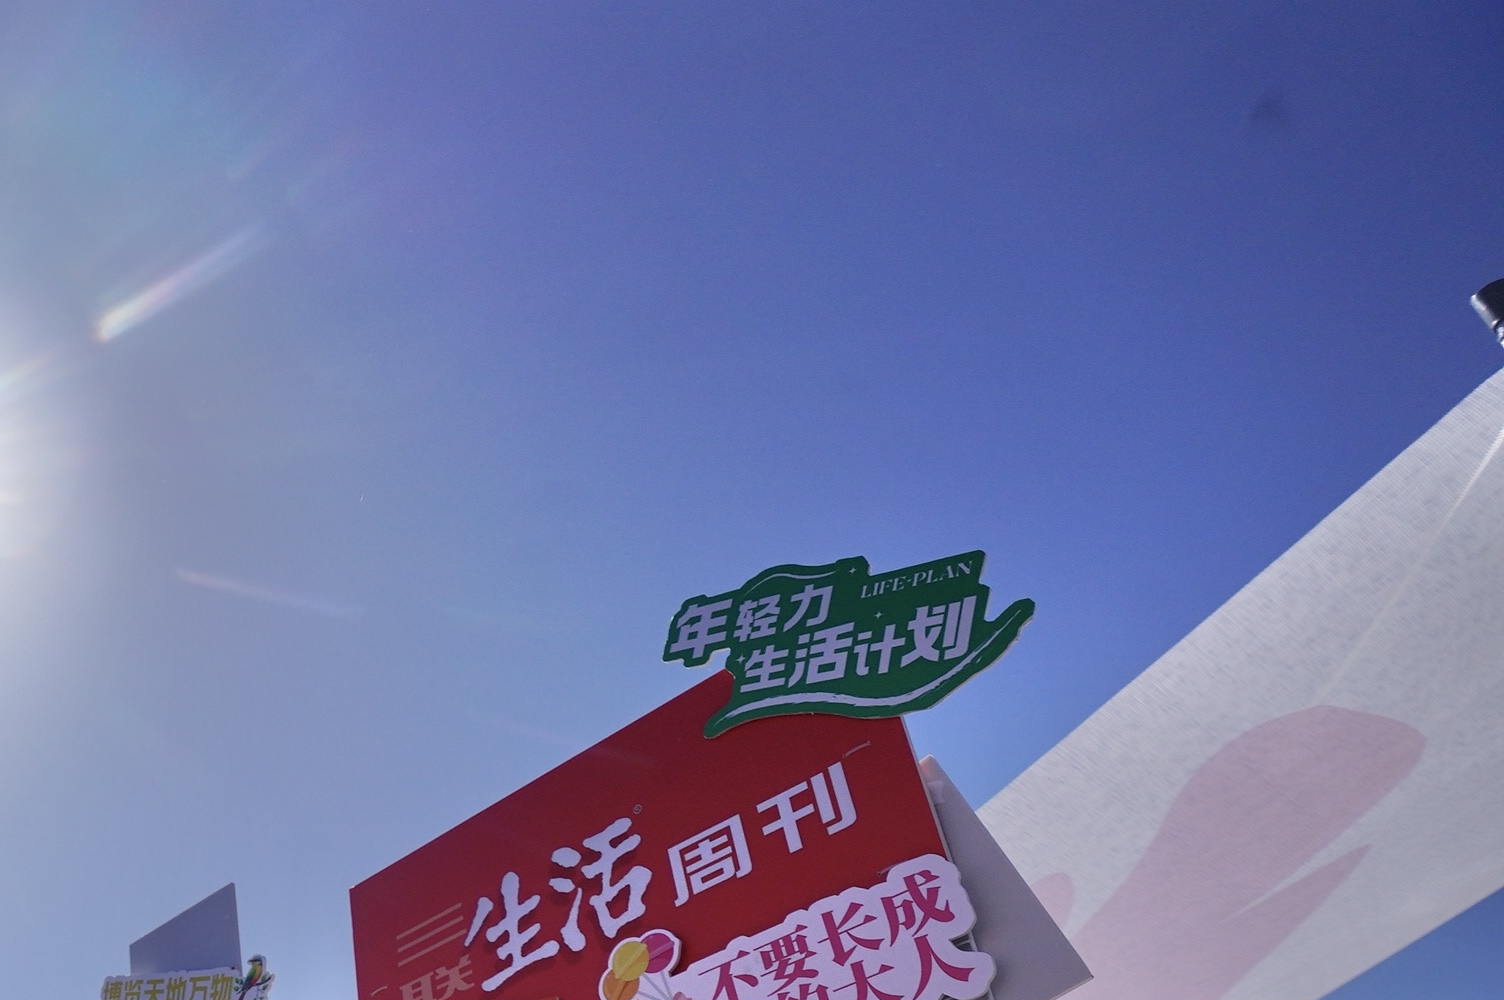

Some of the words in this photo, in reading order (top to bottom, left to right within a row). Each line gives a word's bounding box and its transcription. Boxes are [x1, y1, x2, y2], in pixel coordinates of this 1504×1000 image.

[671, 584, 833, 660] 年轻力
[739, 595, 977, 694] 生活计划
